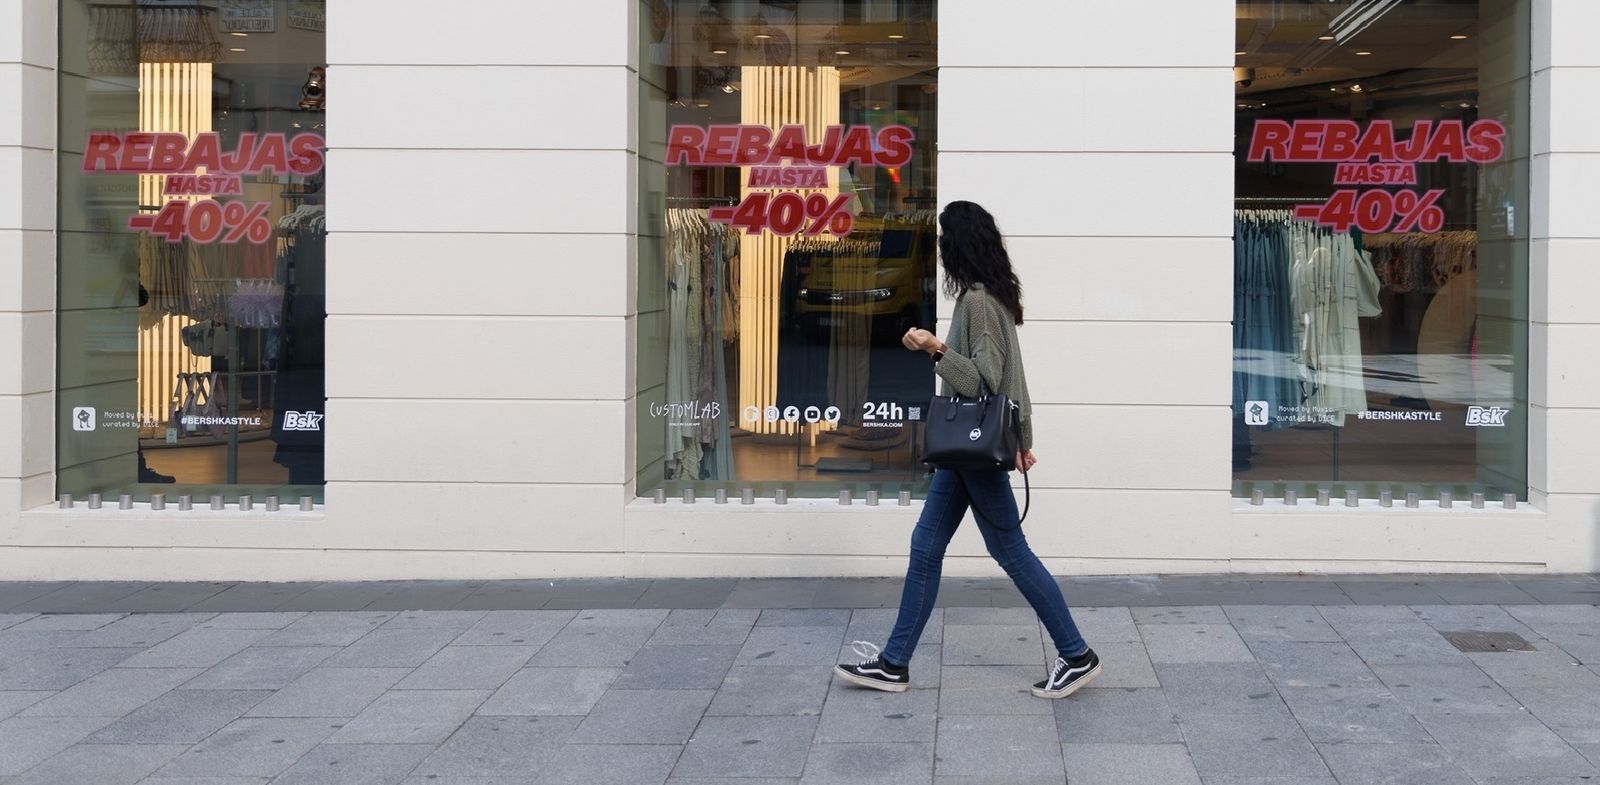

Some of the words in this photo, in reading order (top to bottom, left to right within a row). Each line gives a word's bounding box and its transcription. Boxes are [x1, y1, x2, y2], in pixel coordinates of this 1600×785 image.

[664, 124, 915, 167] REBAJAS
[1247, 119, 1506, 163] REBAJAS
[81, 131, 326, 175] REBAJAS
[748, 167, 828, 188] HASTA
[1333, 163, 1417, 185] HASTA
[163, 175, 243, 195] HASTA
[707, 192, 855, 237] -40%
[1294, 189, 1446, 233] -40%
[127, 200, 272, 244] -40%
[104, 411, 125, 419] Moved
[126, 411, 135, 420] by
[181, 415, 261, 425] #BERSHKASTYLE
[282, 410, 324, 431] Bsk
[862, 402, 903, 420] 24h
[1276, 414, 1306, 422] curated
[1307, 415, 1317, 423] by
[1357, 411, 1442, 421] #BERSHKASTYLE
[1465, 406, 1509, 426] Bsk
[132, 421, 141, 429] by
